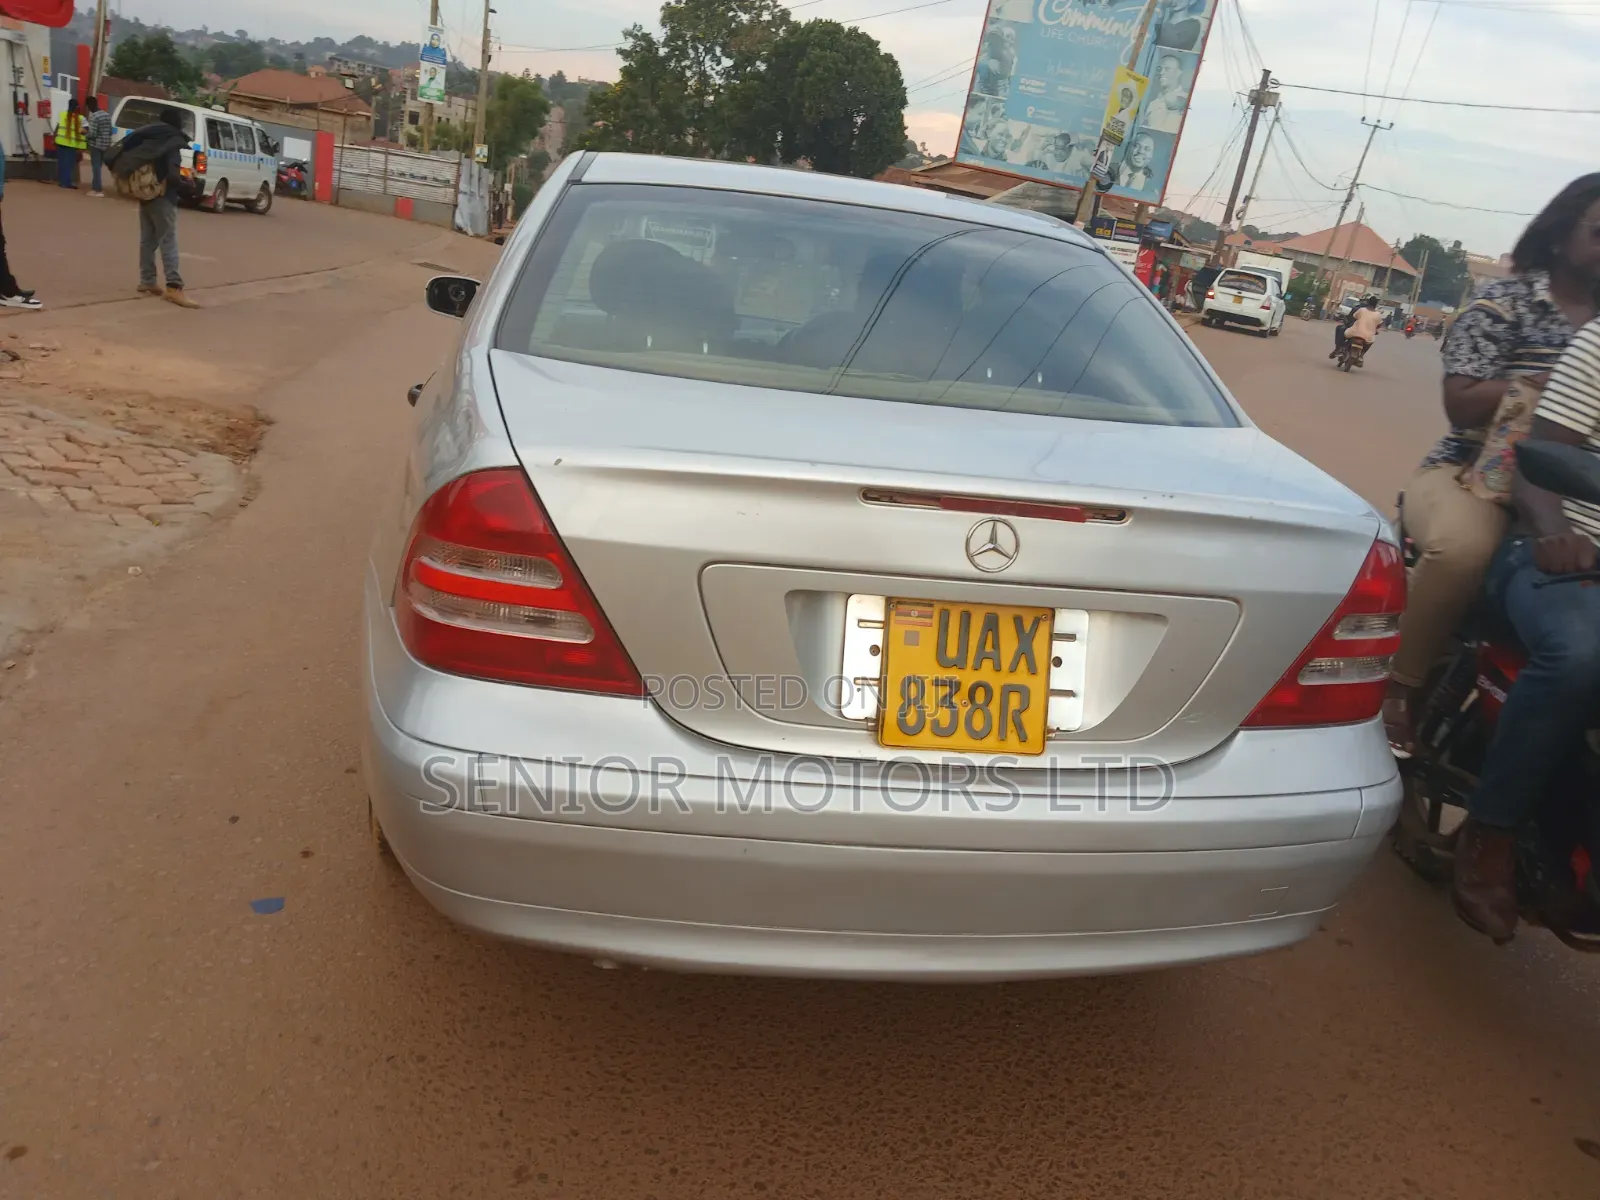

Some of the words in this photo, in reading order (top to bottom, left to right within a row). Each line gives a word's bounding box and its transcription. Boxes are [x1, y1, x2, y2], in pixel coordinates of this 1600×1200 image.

[1040, 27, 1065, 40] LIFE
[1068, 32, 1121, 50] CHURCH
[936, 609, 1041, 674] UAX
[897, 675, 1031, 743] 838R
